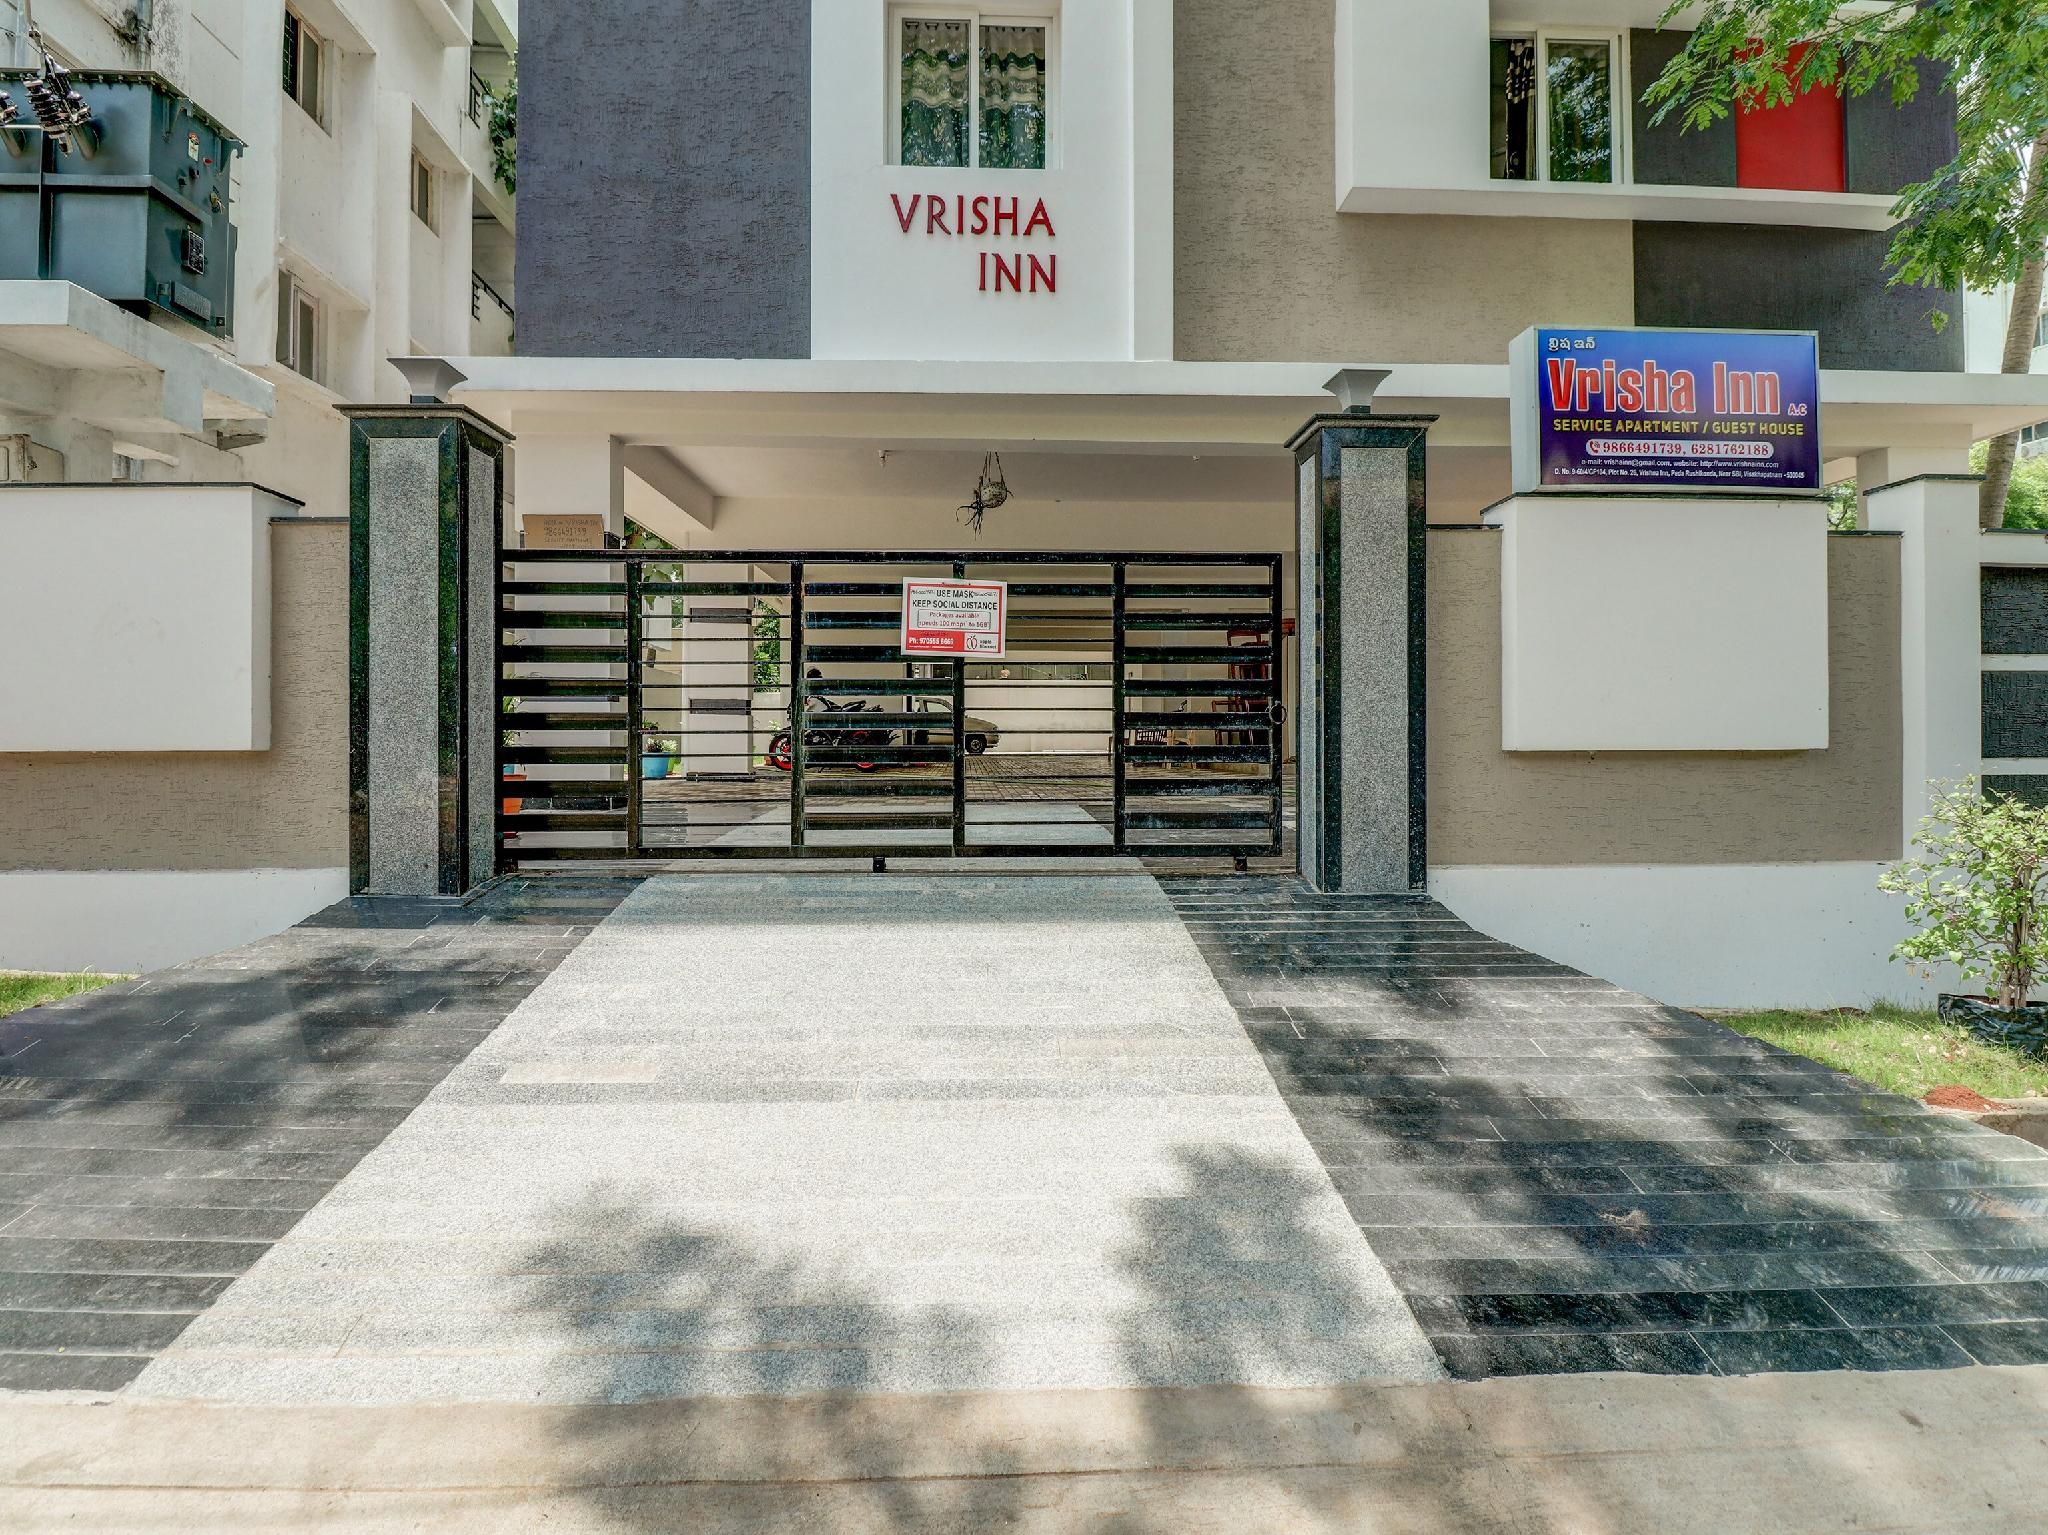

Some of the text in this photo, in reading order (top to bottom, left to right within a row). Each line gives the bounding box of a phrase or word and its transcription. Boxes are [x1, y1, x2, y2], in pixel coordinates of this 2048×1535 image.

[890, 193, 1056, 236] VRISHA
[979, 252, 1056, 292] INN
[1547, 357, 1781, 415] Vrisha Inn
[1787, 403, 1808, 416] A.C
[1553, 419, 1804, 435] SERVICE APARTMENT / GUEST HOUSE
[1603, 442, 1769, 455] 9866491739, 6281762188
[936, 589, 951, 598] USE
[952, 590, 974, 599] MASK
[912, 600, 998, 610] KEEP SOCIAL DISTANCE
